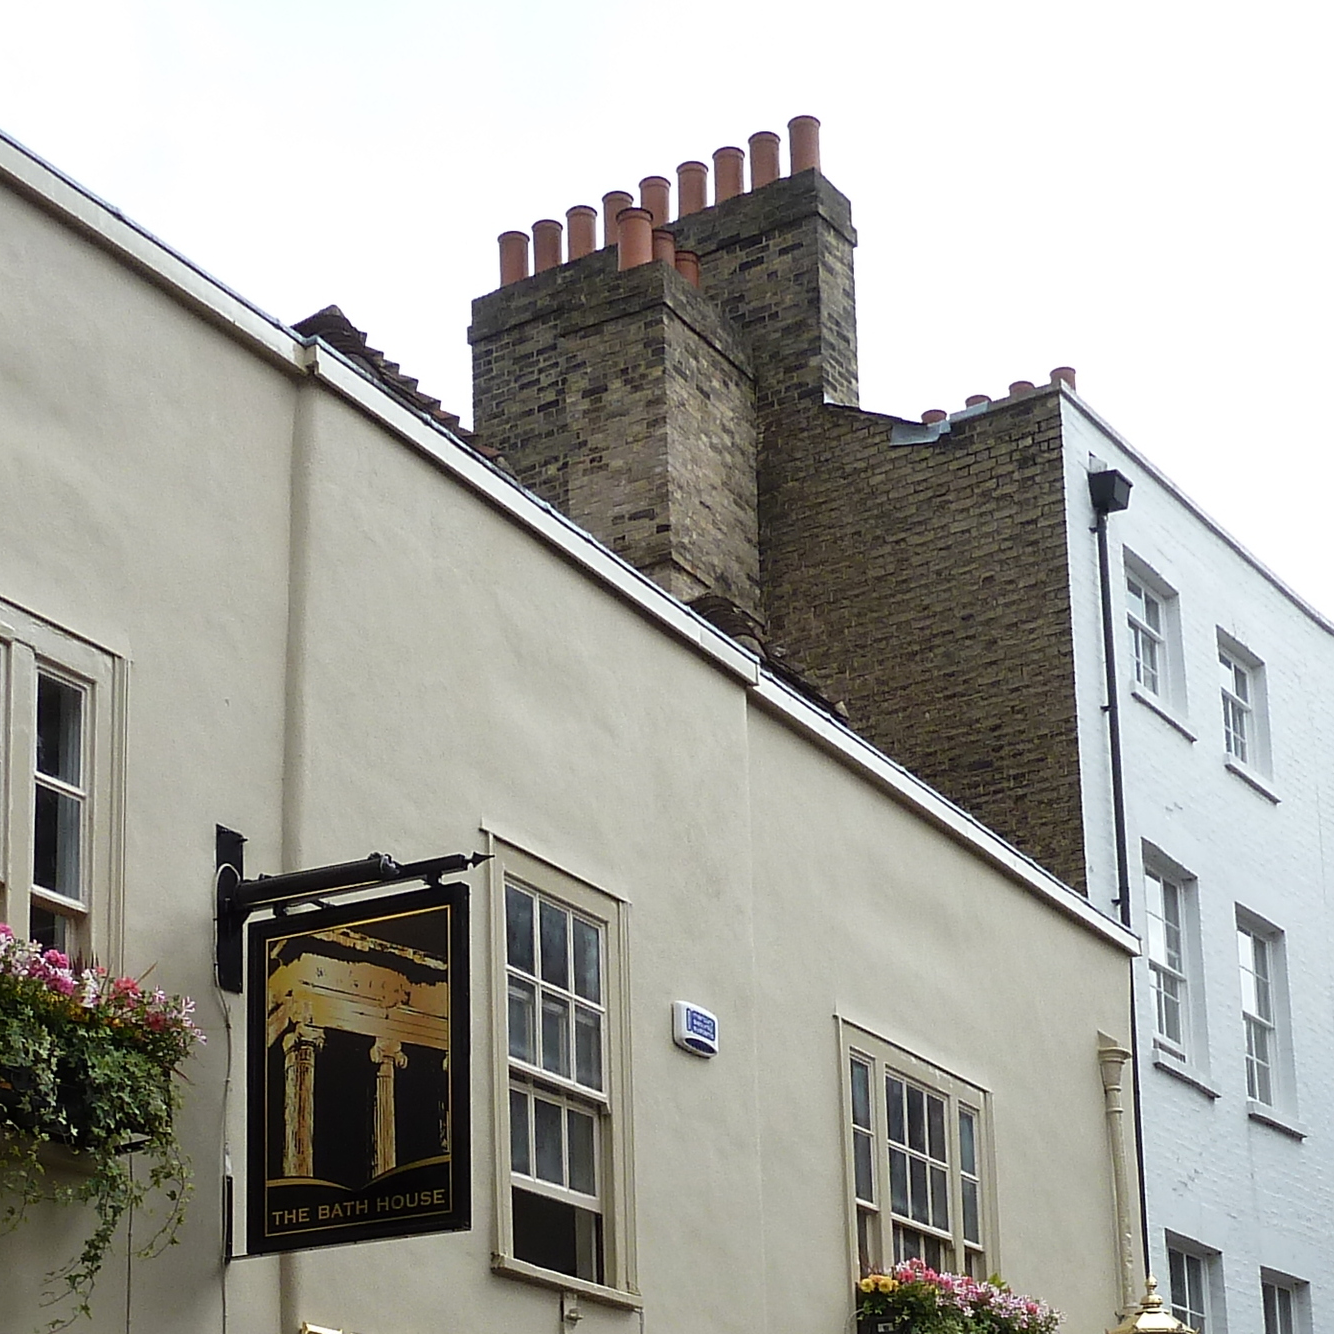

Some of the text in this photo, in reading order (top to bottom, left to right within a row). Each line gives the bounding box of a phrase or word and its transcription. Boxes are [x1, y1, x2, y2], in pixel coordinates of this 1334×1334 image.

[272, 1189, 445, 1226] THE BATH HOUSE
